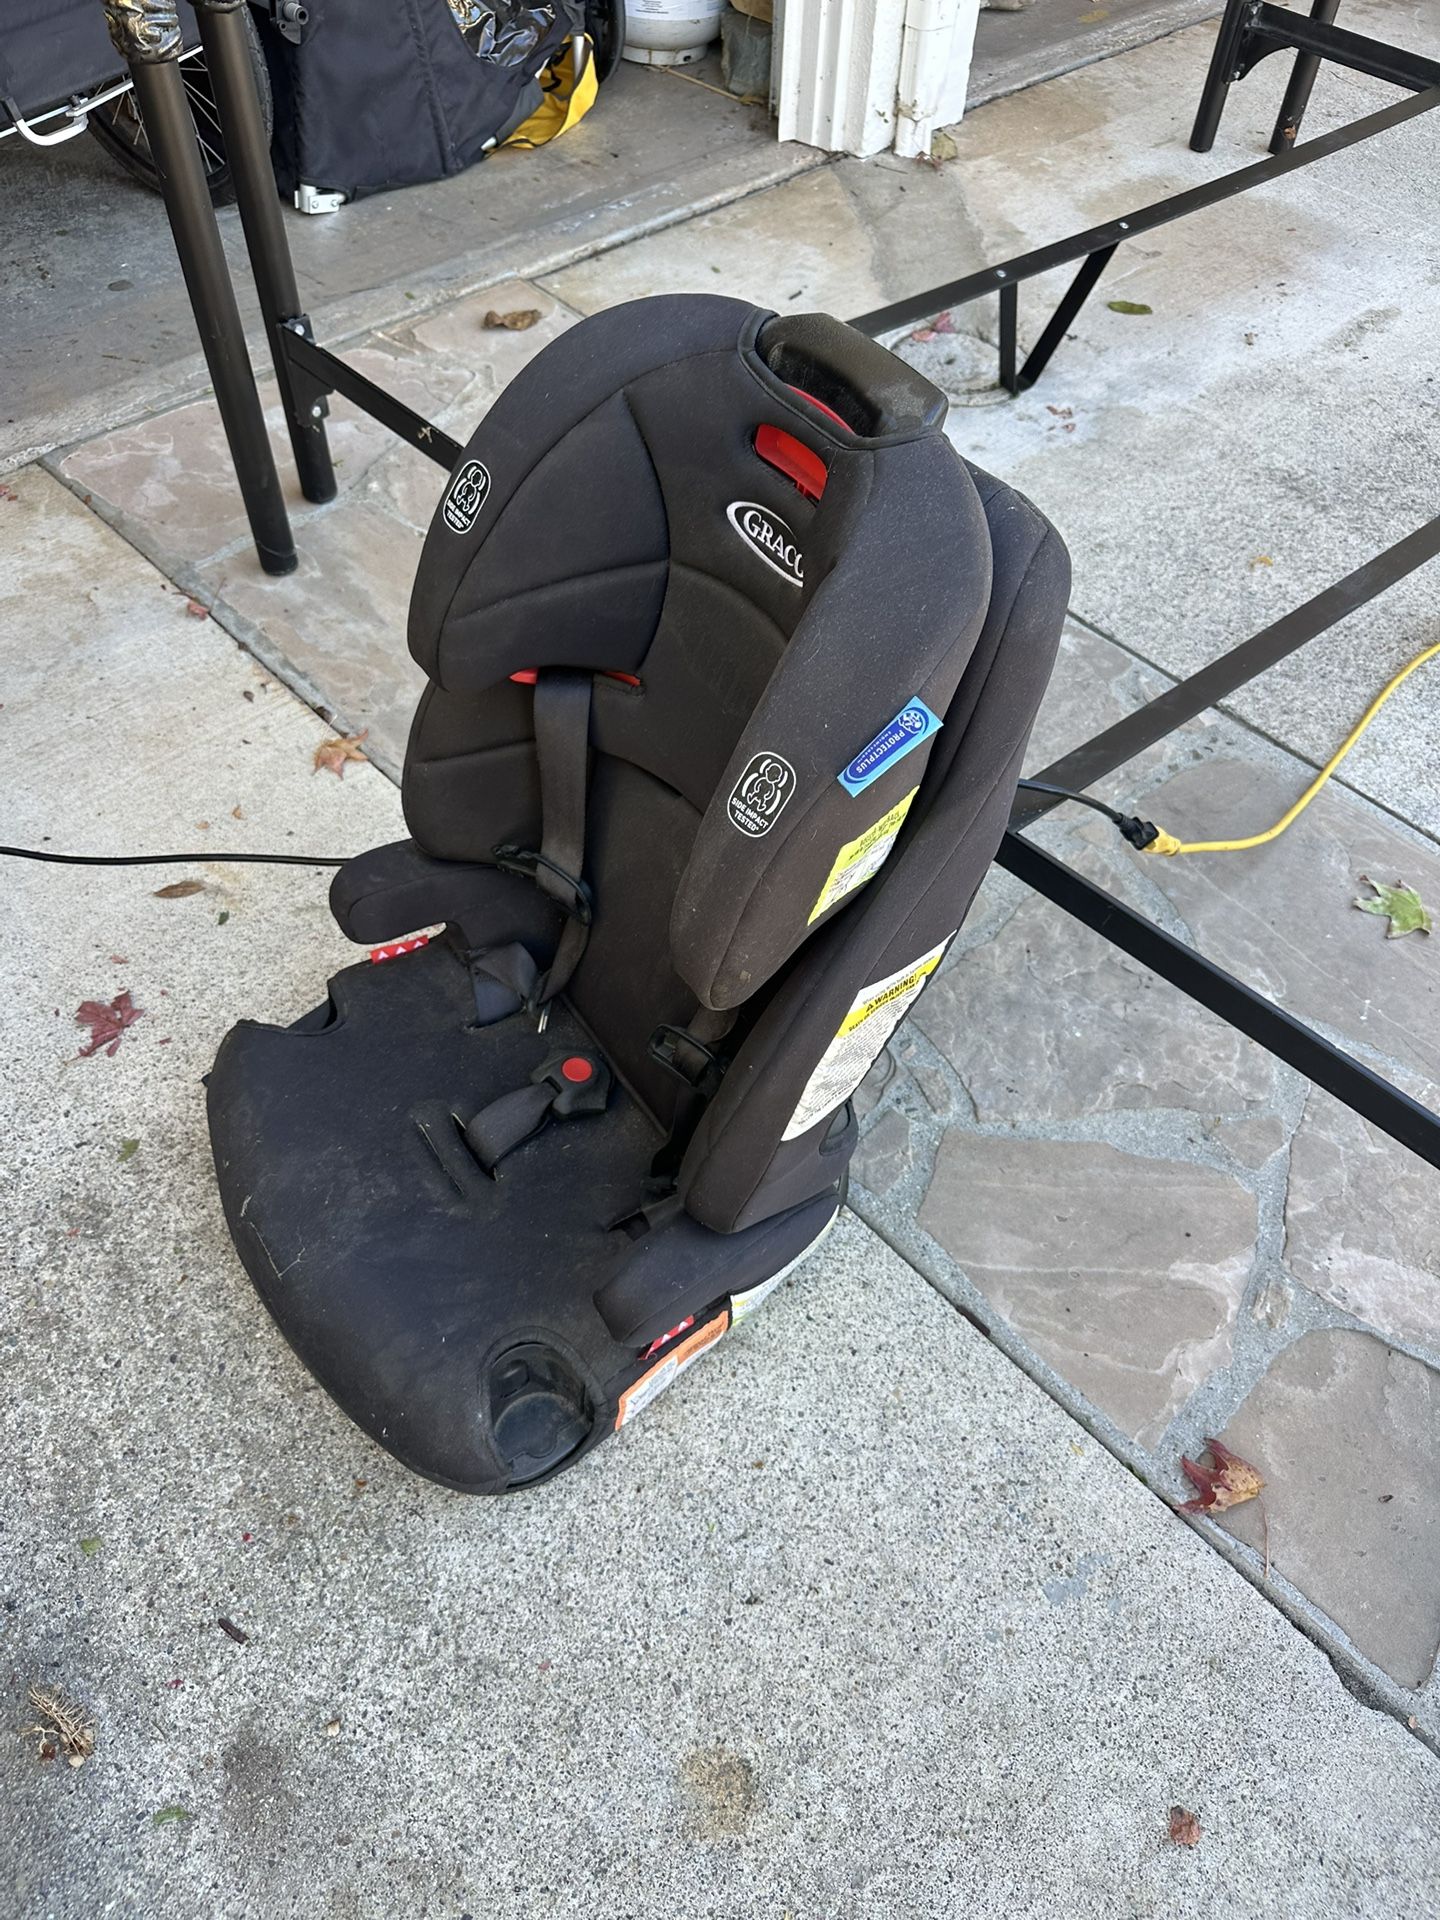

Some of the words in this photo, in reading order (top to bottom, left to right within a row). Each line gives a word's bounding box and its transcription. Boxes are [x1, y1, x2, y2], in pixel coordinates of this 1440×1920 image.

[856, 730, 906, 773] PROTECTPLUS
[731, 797, 747, 812] SIDE
[745, 808, 769, 829] IMPACT
[874, 973, 917, 1006] WARNING!
